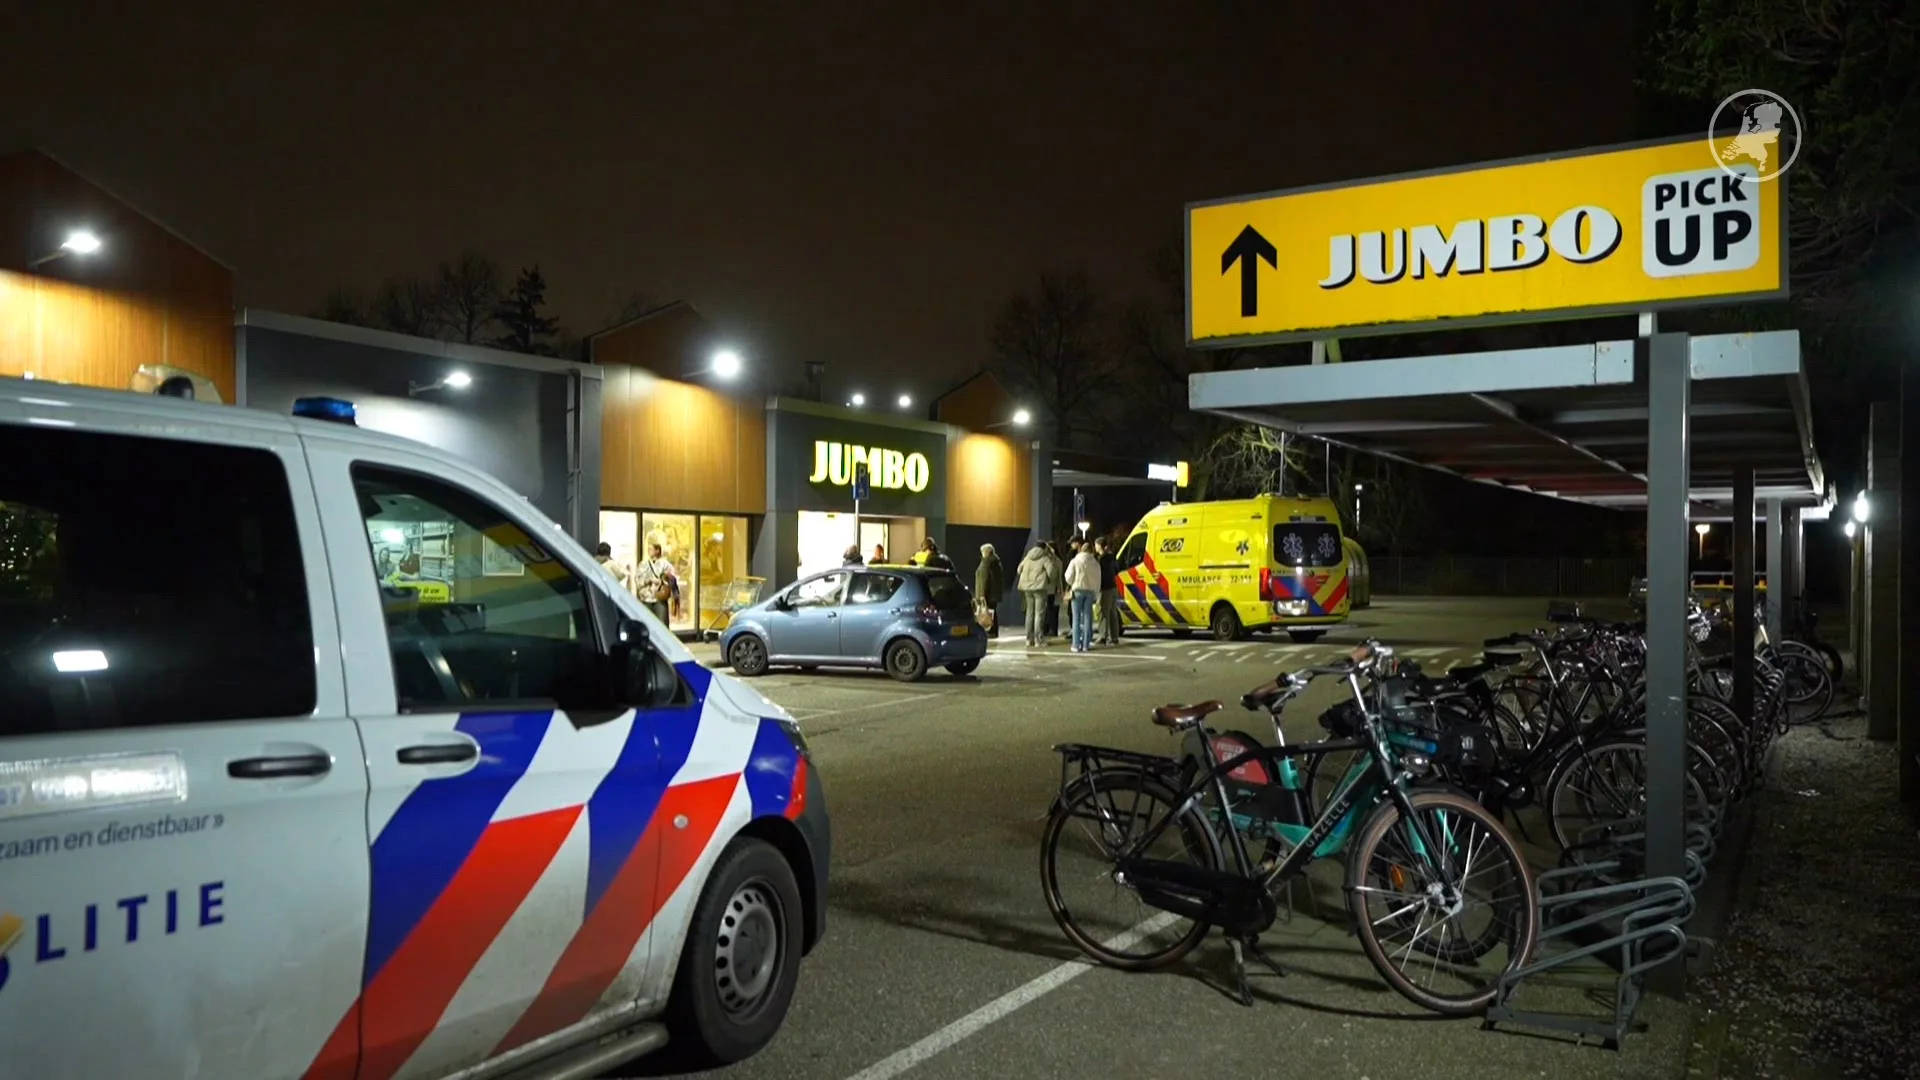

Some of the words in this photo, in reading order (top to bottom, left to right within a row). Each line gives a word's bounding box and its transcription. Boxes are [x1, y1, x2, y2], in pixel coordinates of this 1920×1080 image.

[1655, 172, 1748, 212] PICK
[1318, 204, 1622, 289] JUMBO
[1655, 209, 1752, 267] UP
[809, 439, 930, 492] JUMBO
[63, 829, 92, 851] en
[96, 814, 210, 847] dienstbaar
[1305, 799, 1350, 848] GAZELLE
